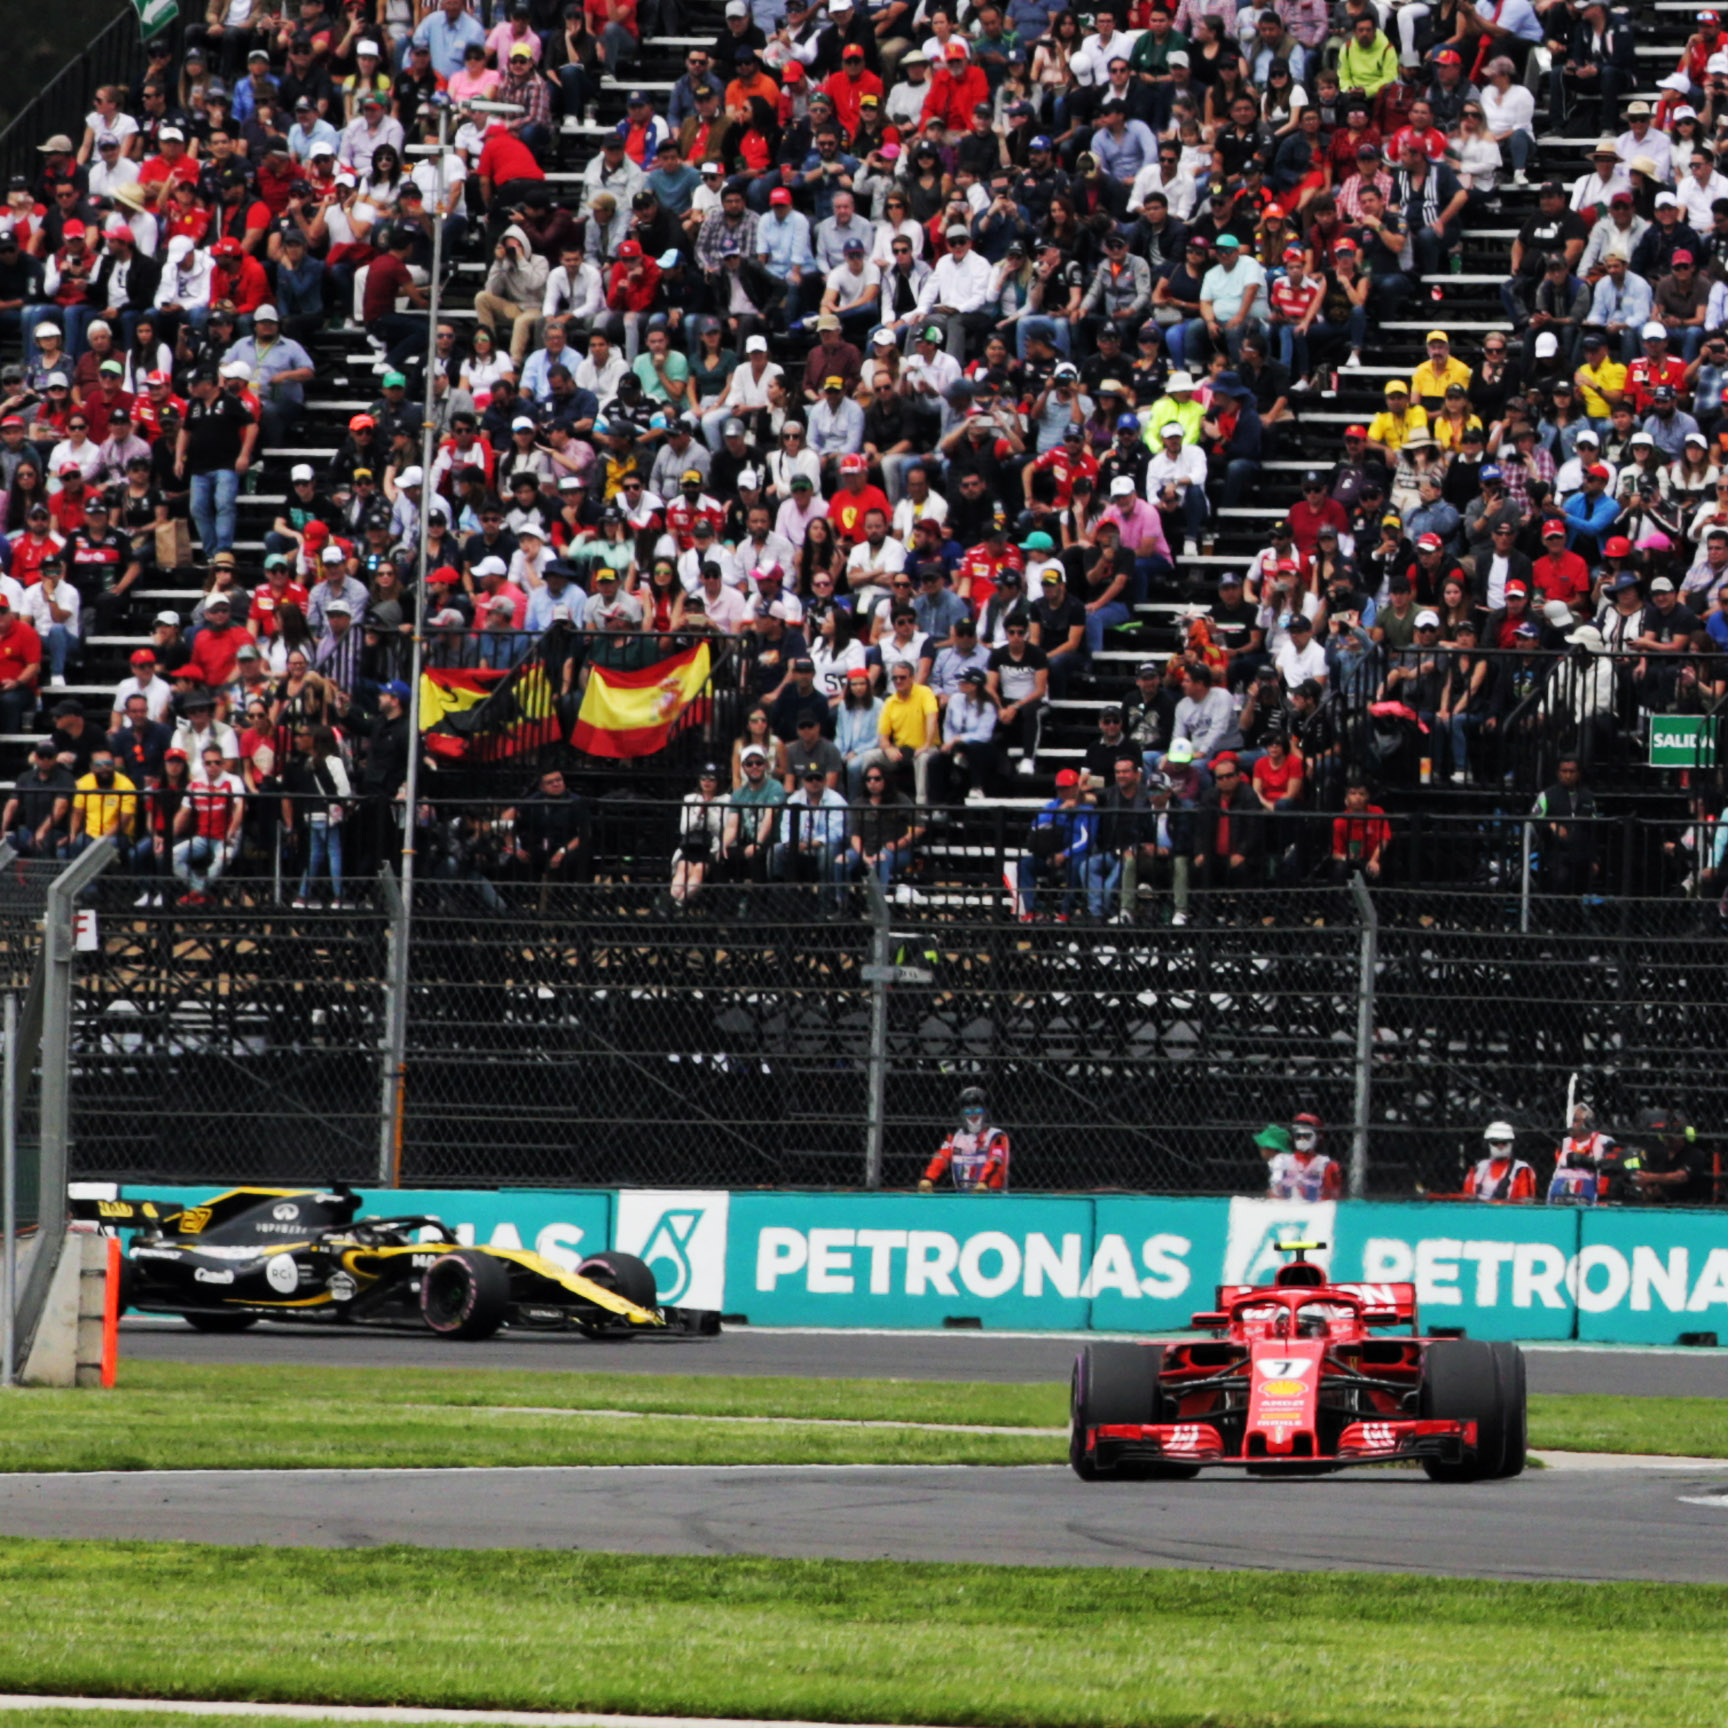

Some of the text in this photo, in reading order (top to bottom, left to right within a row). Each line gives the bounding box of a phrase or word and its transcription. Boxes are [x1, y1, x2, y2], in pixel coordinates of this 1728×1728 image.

[1653, 732, 1715, 750] SALIDA
[757, 1226, 1191, 1299] PETRONAS
[1274, 1361, 1293, 1376] 7
